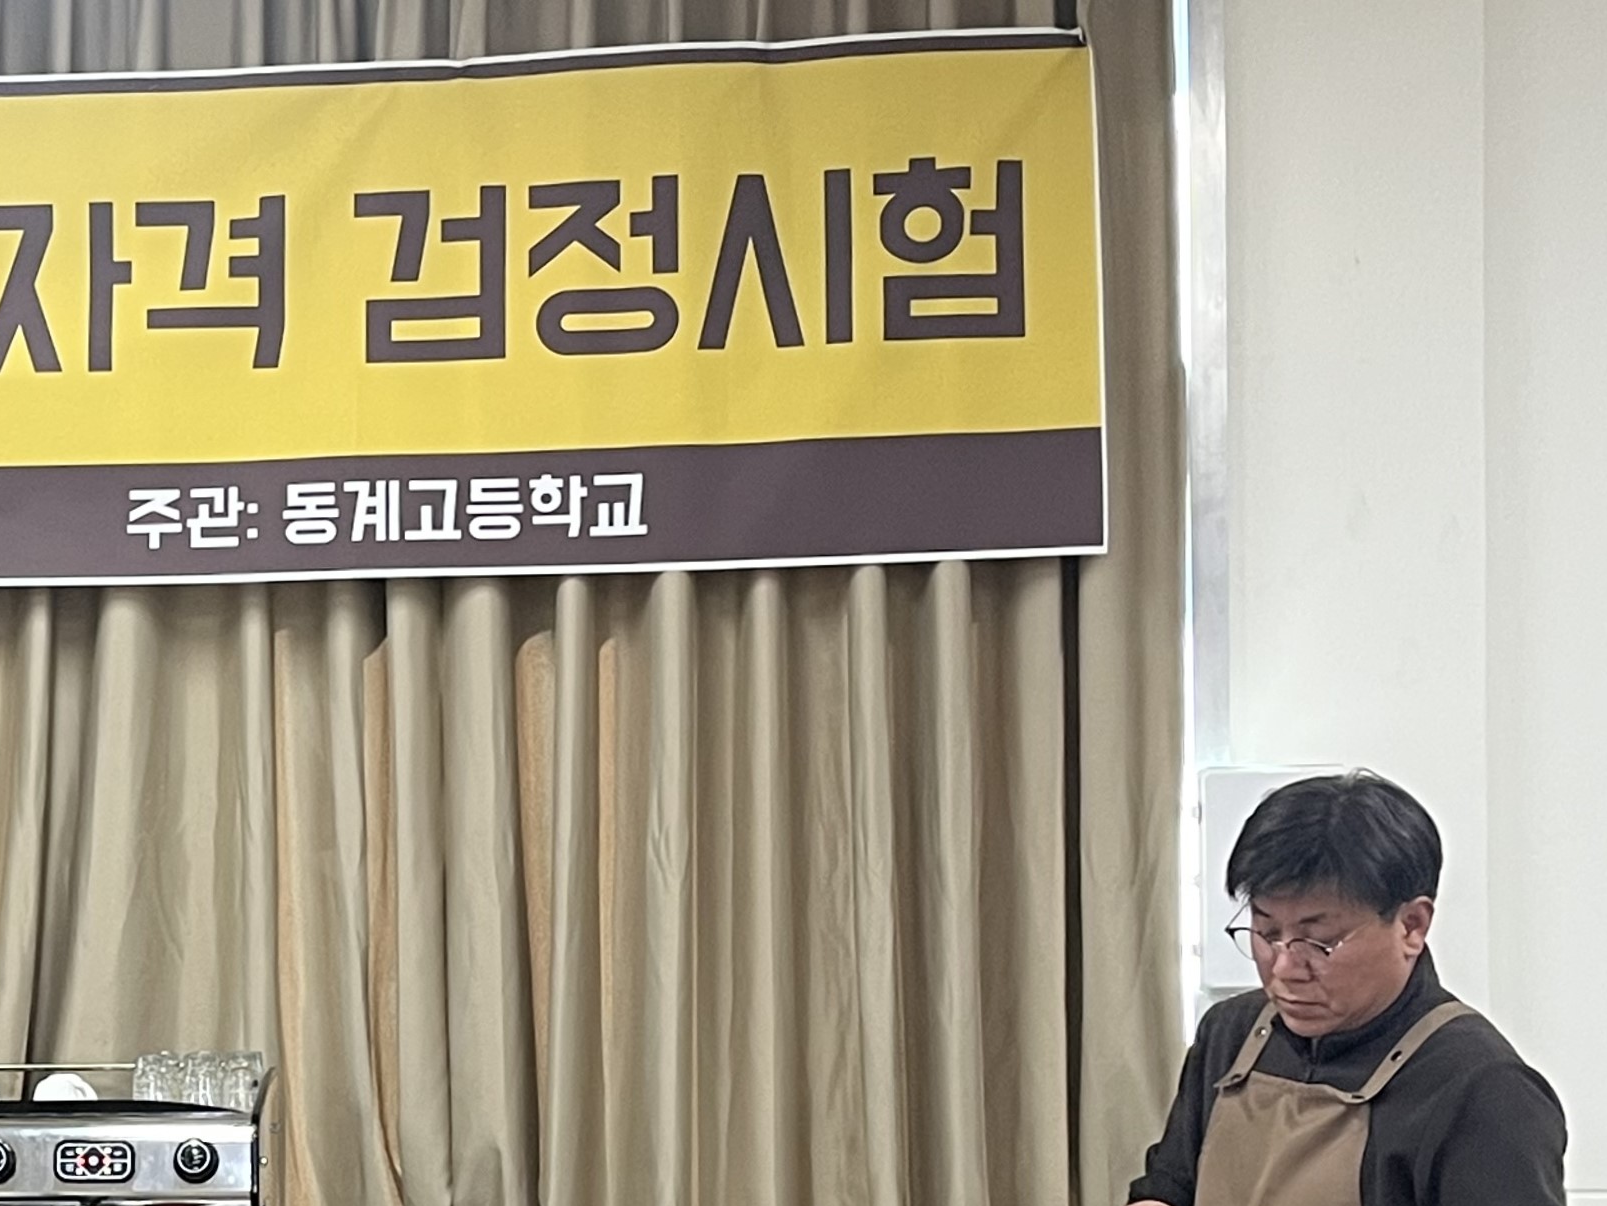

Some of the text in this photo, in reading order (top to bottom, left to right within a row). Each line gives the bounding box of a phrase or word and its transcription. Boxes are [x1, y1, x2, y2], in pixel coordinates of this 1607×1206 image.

[354, 157, 1026, 364] 검정시험
[126, 473, 648, 551] 주관: 동계고등학교
